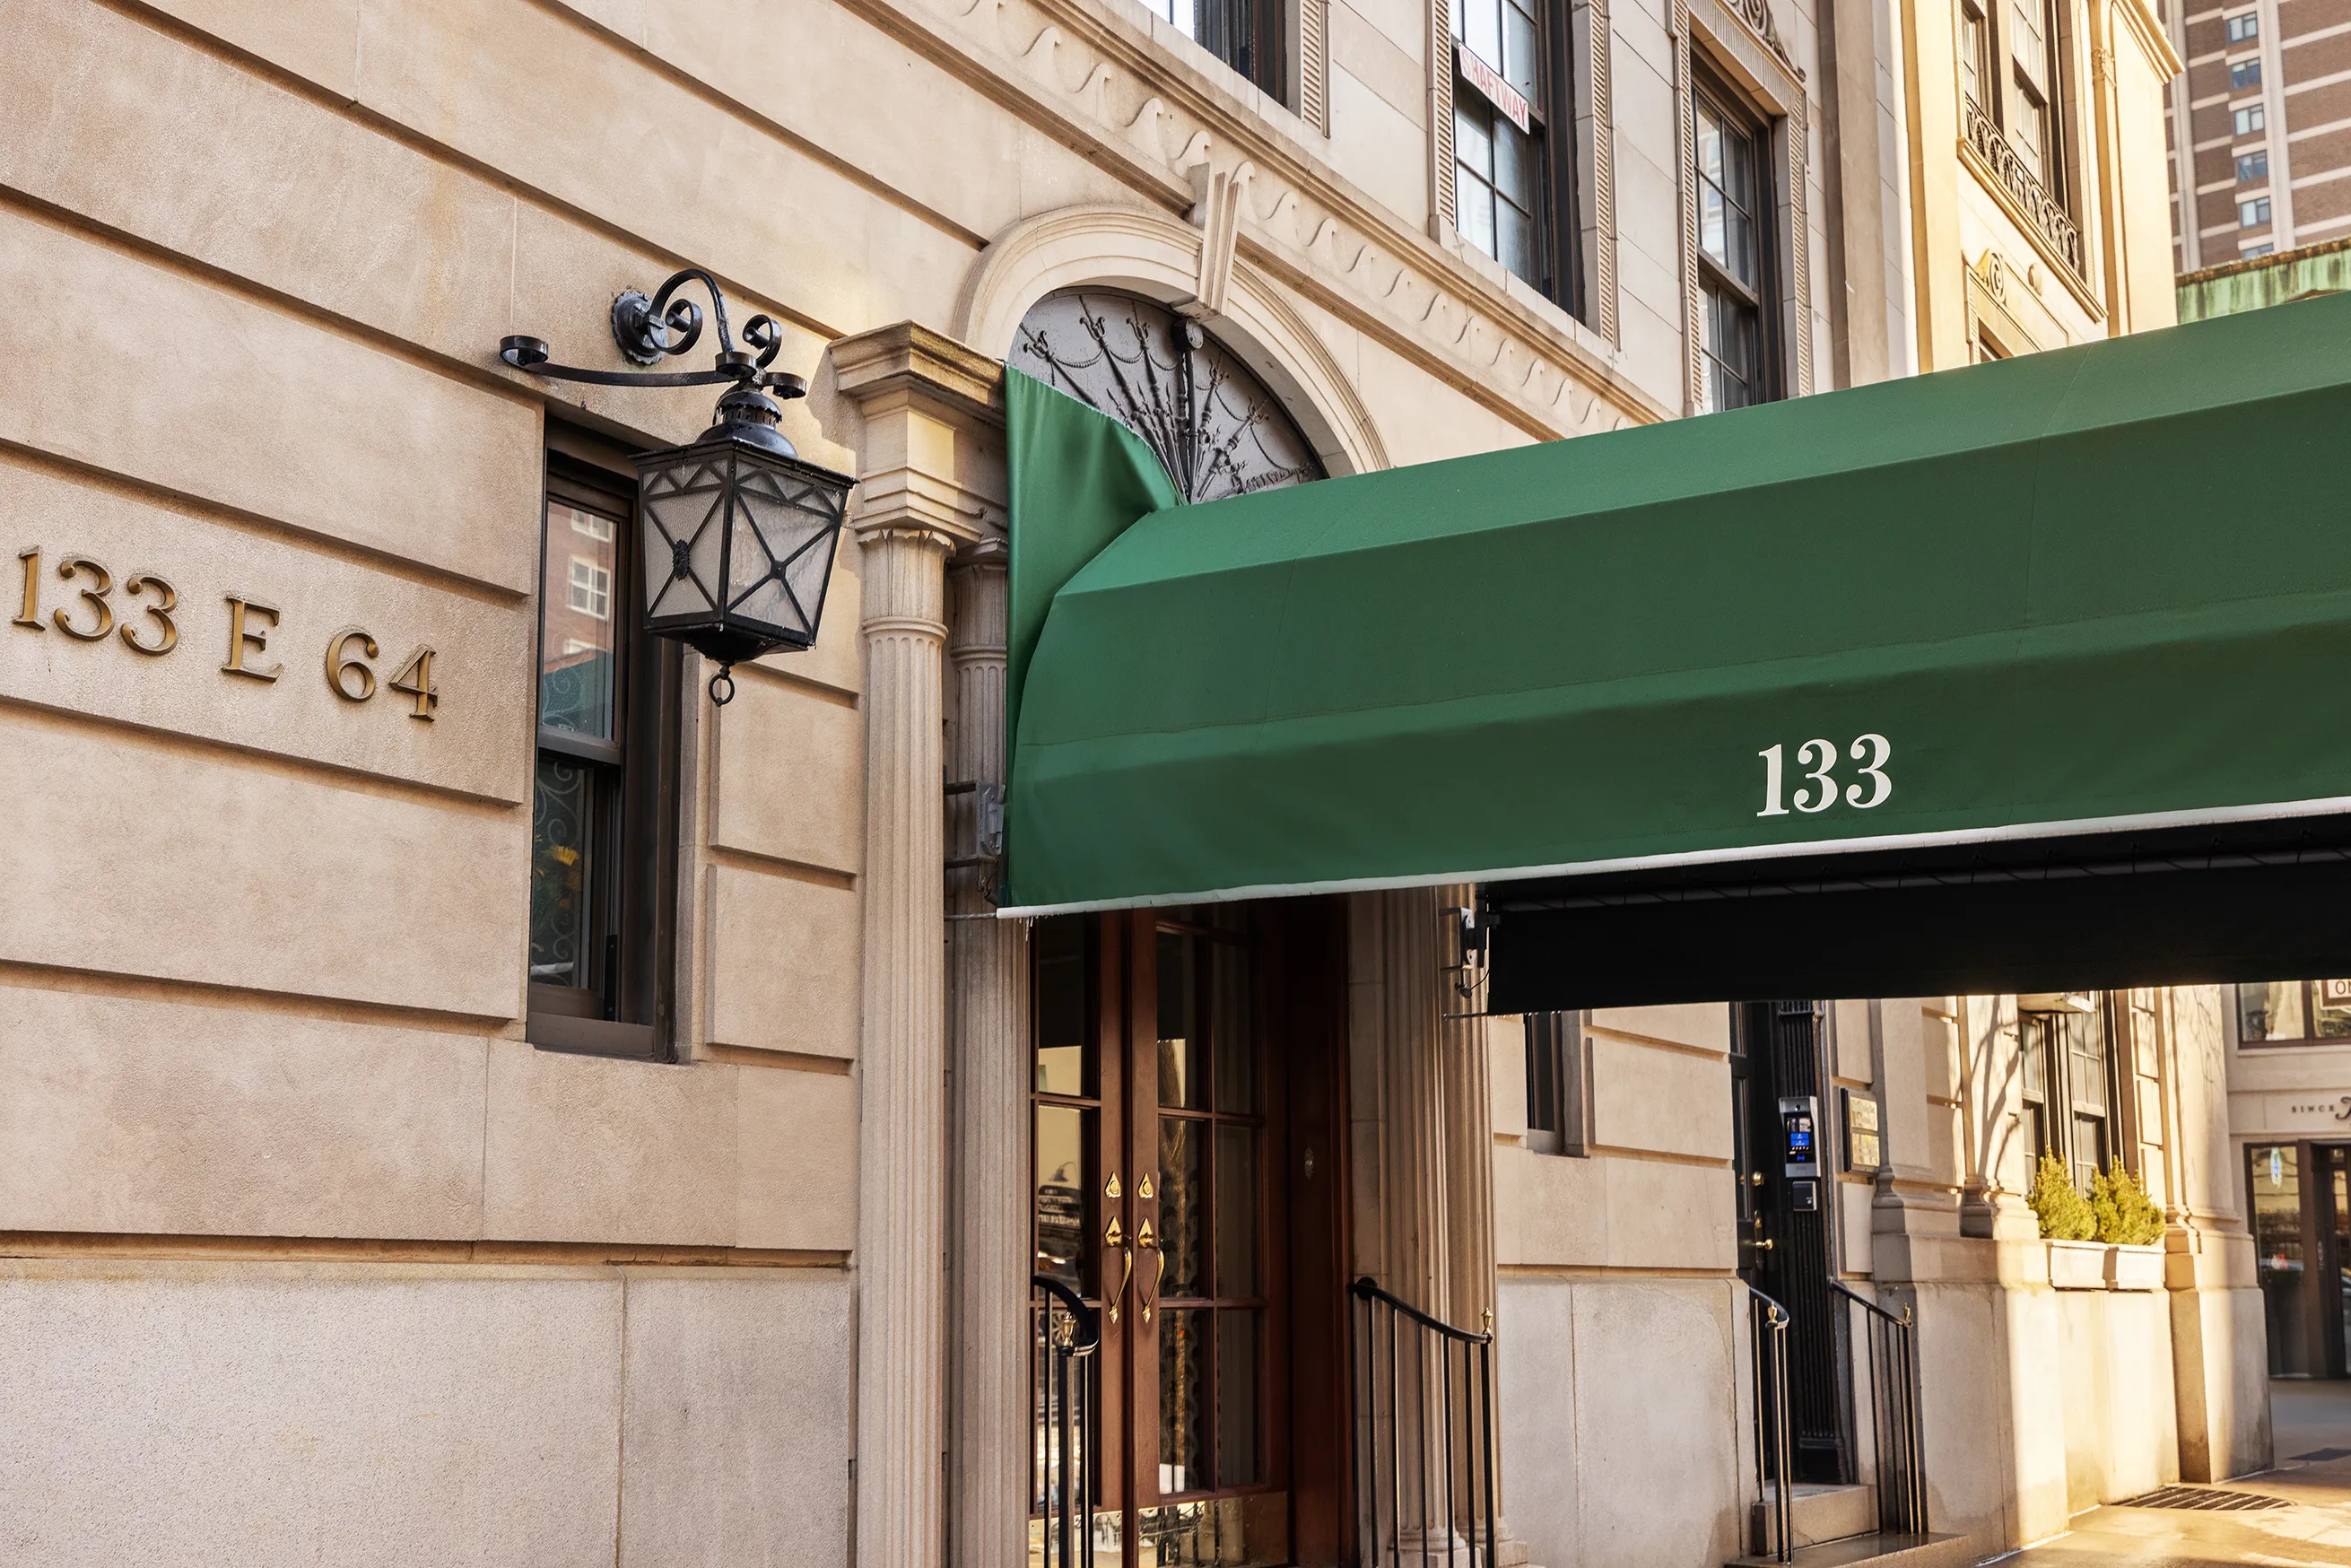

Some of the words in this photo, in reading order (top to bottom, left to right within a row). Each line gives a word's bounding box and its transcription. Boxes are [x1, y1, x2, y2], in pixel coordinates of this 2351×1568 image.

[1460, 48, 1528, 127] SHAFTWAY
[13, 545, 179, 657] 133
[221, 596, 284, 684] E
[326, 629, 440, 723] 64
[1756, 733, 1892, 817] 133
[2291, 1104, 2335, 1113] SINCE
